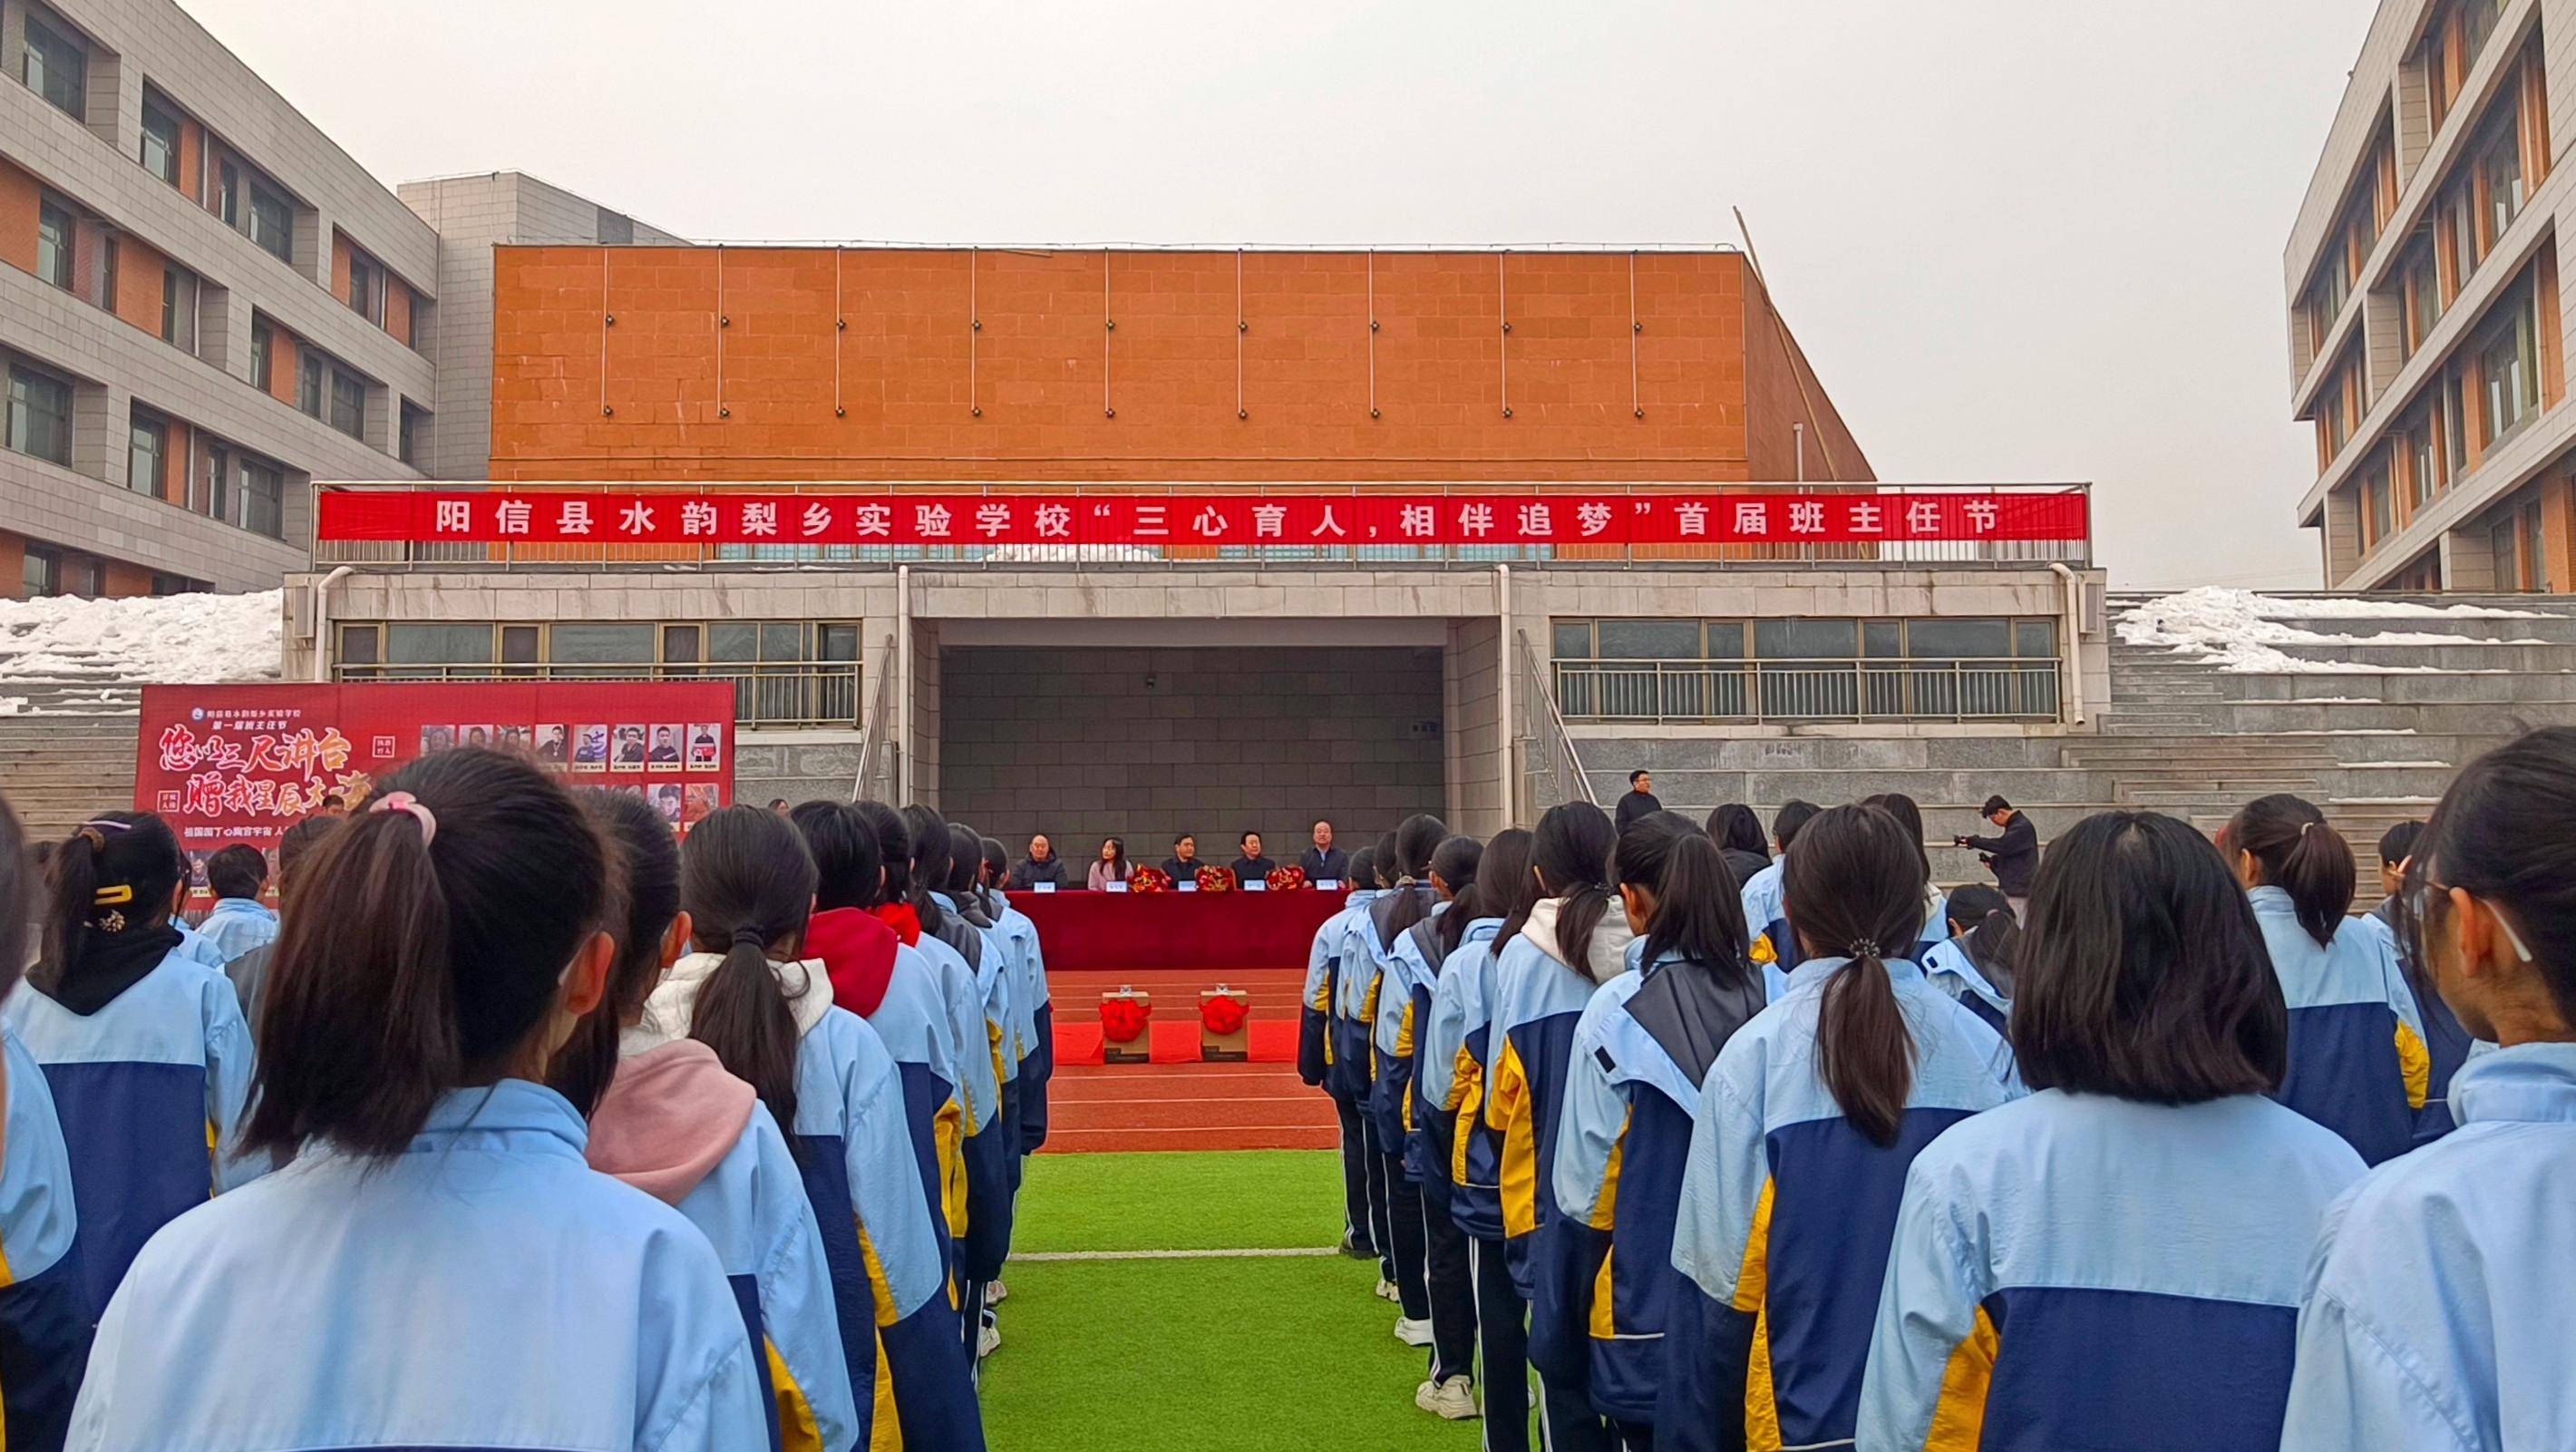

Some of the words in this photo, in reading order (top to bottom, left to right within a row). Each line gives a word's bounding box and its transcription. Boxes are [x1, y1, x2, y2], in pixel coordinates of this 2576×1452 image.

[159, 724, 352, 782] 您以三尺讲台
[183, 770, 373, 817] 赠我星辰大海
